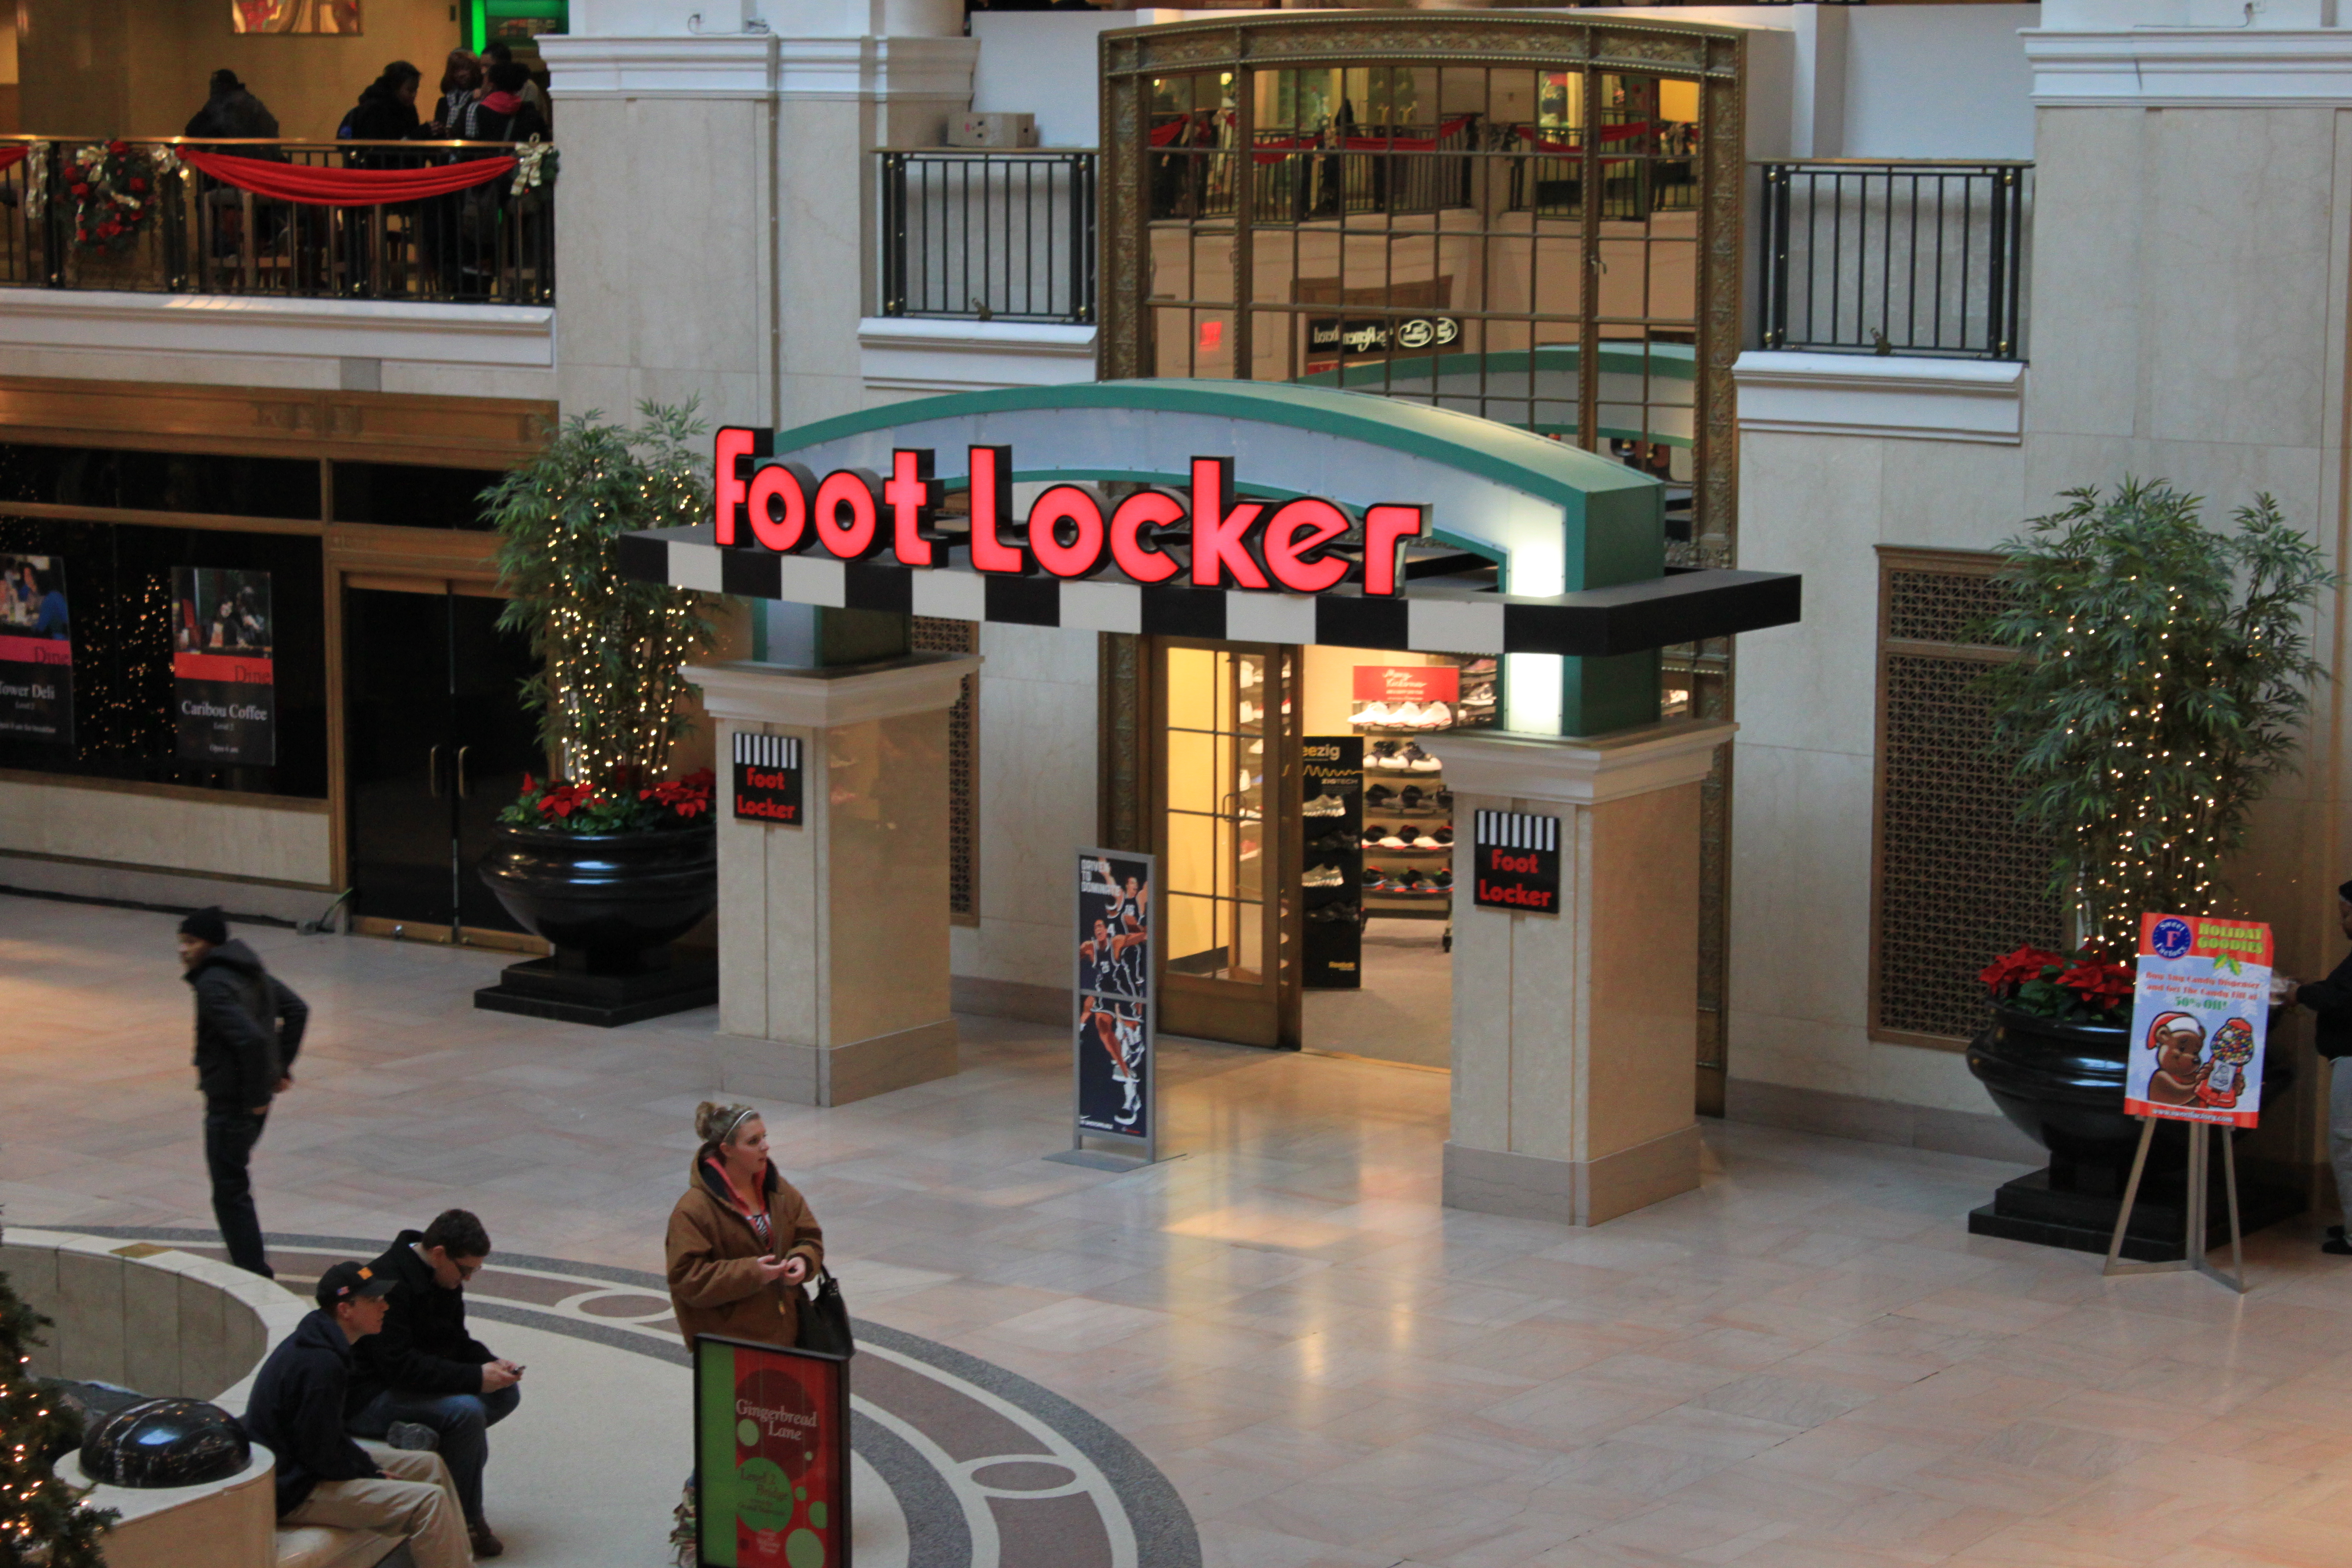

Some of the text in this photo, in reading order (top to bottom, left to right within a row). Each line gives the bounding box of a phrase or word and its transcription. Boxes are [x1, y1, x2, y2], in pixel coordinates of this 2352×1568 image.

[714, 425, 1425, 598] Foot Locker
[32, 684, 55, 700] Deli
[181, 699, 267, 721] Caribou Coffee
[746, 767, 785, 789] Foot
[737, 795, 795, 819] Locker
[1491, 849, 1539, 874] Foot
[1479, 879, 1552, 907] Locker
[2165, 931, 2181, 947] F
[2198, 923, 2263, 940] HOLIDAY
[2197, 937, 2263, 954] GOODIES
[736, 1398, 818, 1427] Gingerbread
[768, 1421, 802, 1441] Lane
